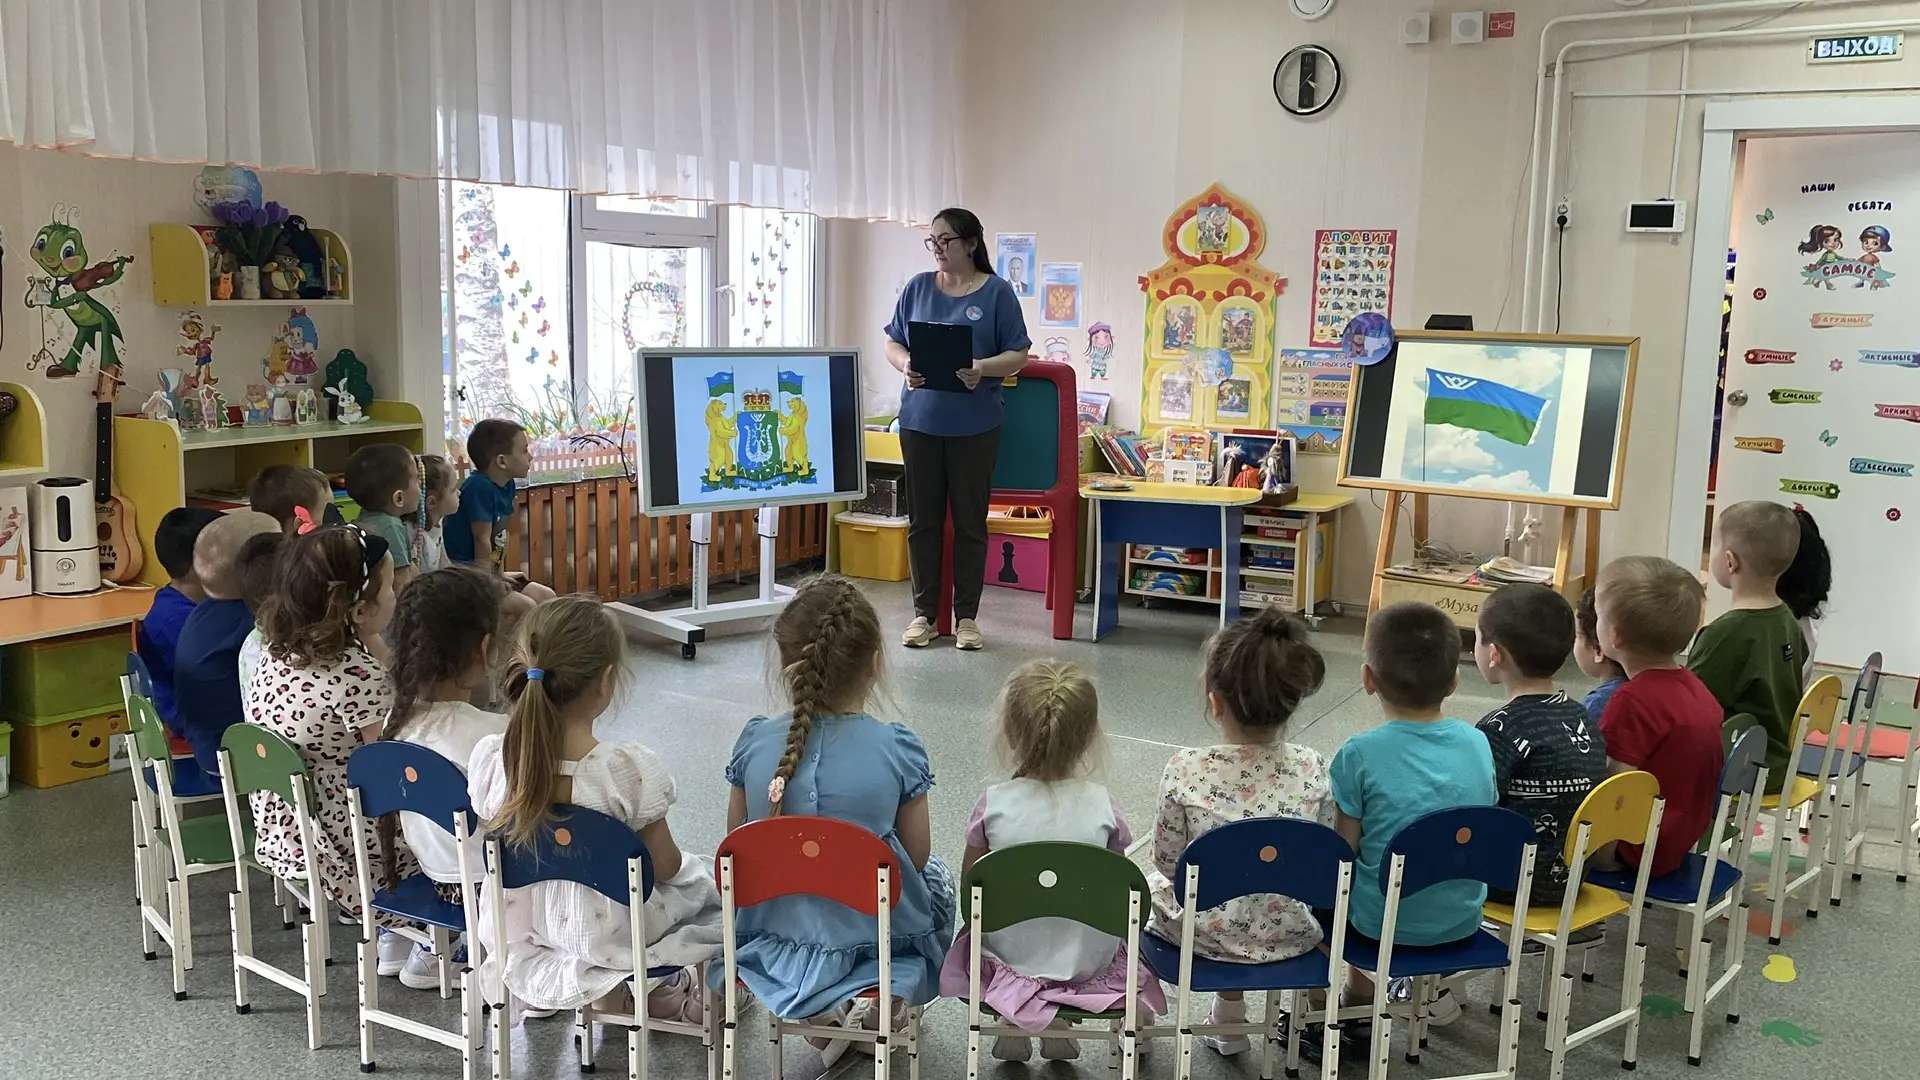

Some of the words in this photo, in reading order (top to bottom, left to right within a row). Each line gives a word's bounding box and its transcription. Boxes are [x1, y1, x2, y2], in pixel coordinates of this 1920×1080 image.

[1817, 36, 1894, 58] ВЫХОД
[1801, 183, 1836, 194] НАШИ
[1848, 201, 1892, 212] РЕБЯТА
[1322, 232, 1390, 244] АЛФАВИТ
[1822, 263, 1877, 278] САМЫЕ
[1760, 353, 1790, 361] УМНЫЕ
[1864, 353, 1912, 362] АКТИВНЫЕ
[1782, 392, 1816, 401] СМЕЛЫЕ
[1882, 407, 1911, 416] ЯРКИЕ
[1791, 483, 1824, 493] ДОБРЫЕ
